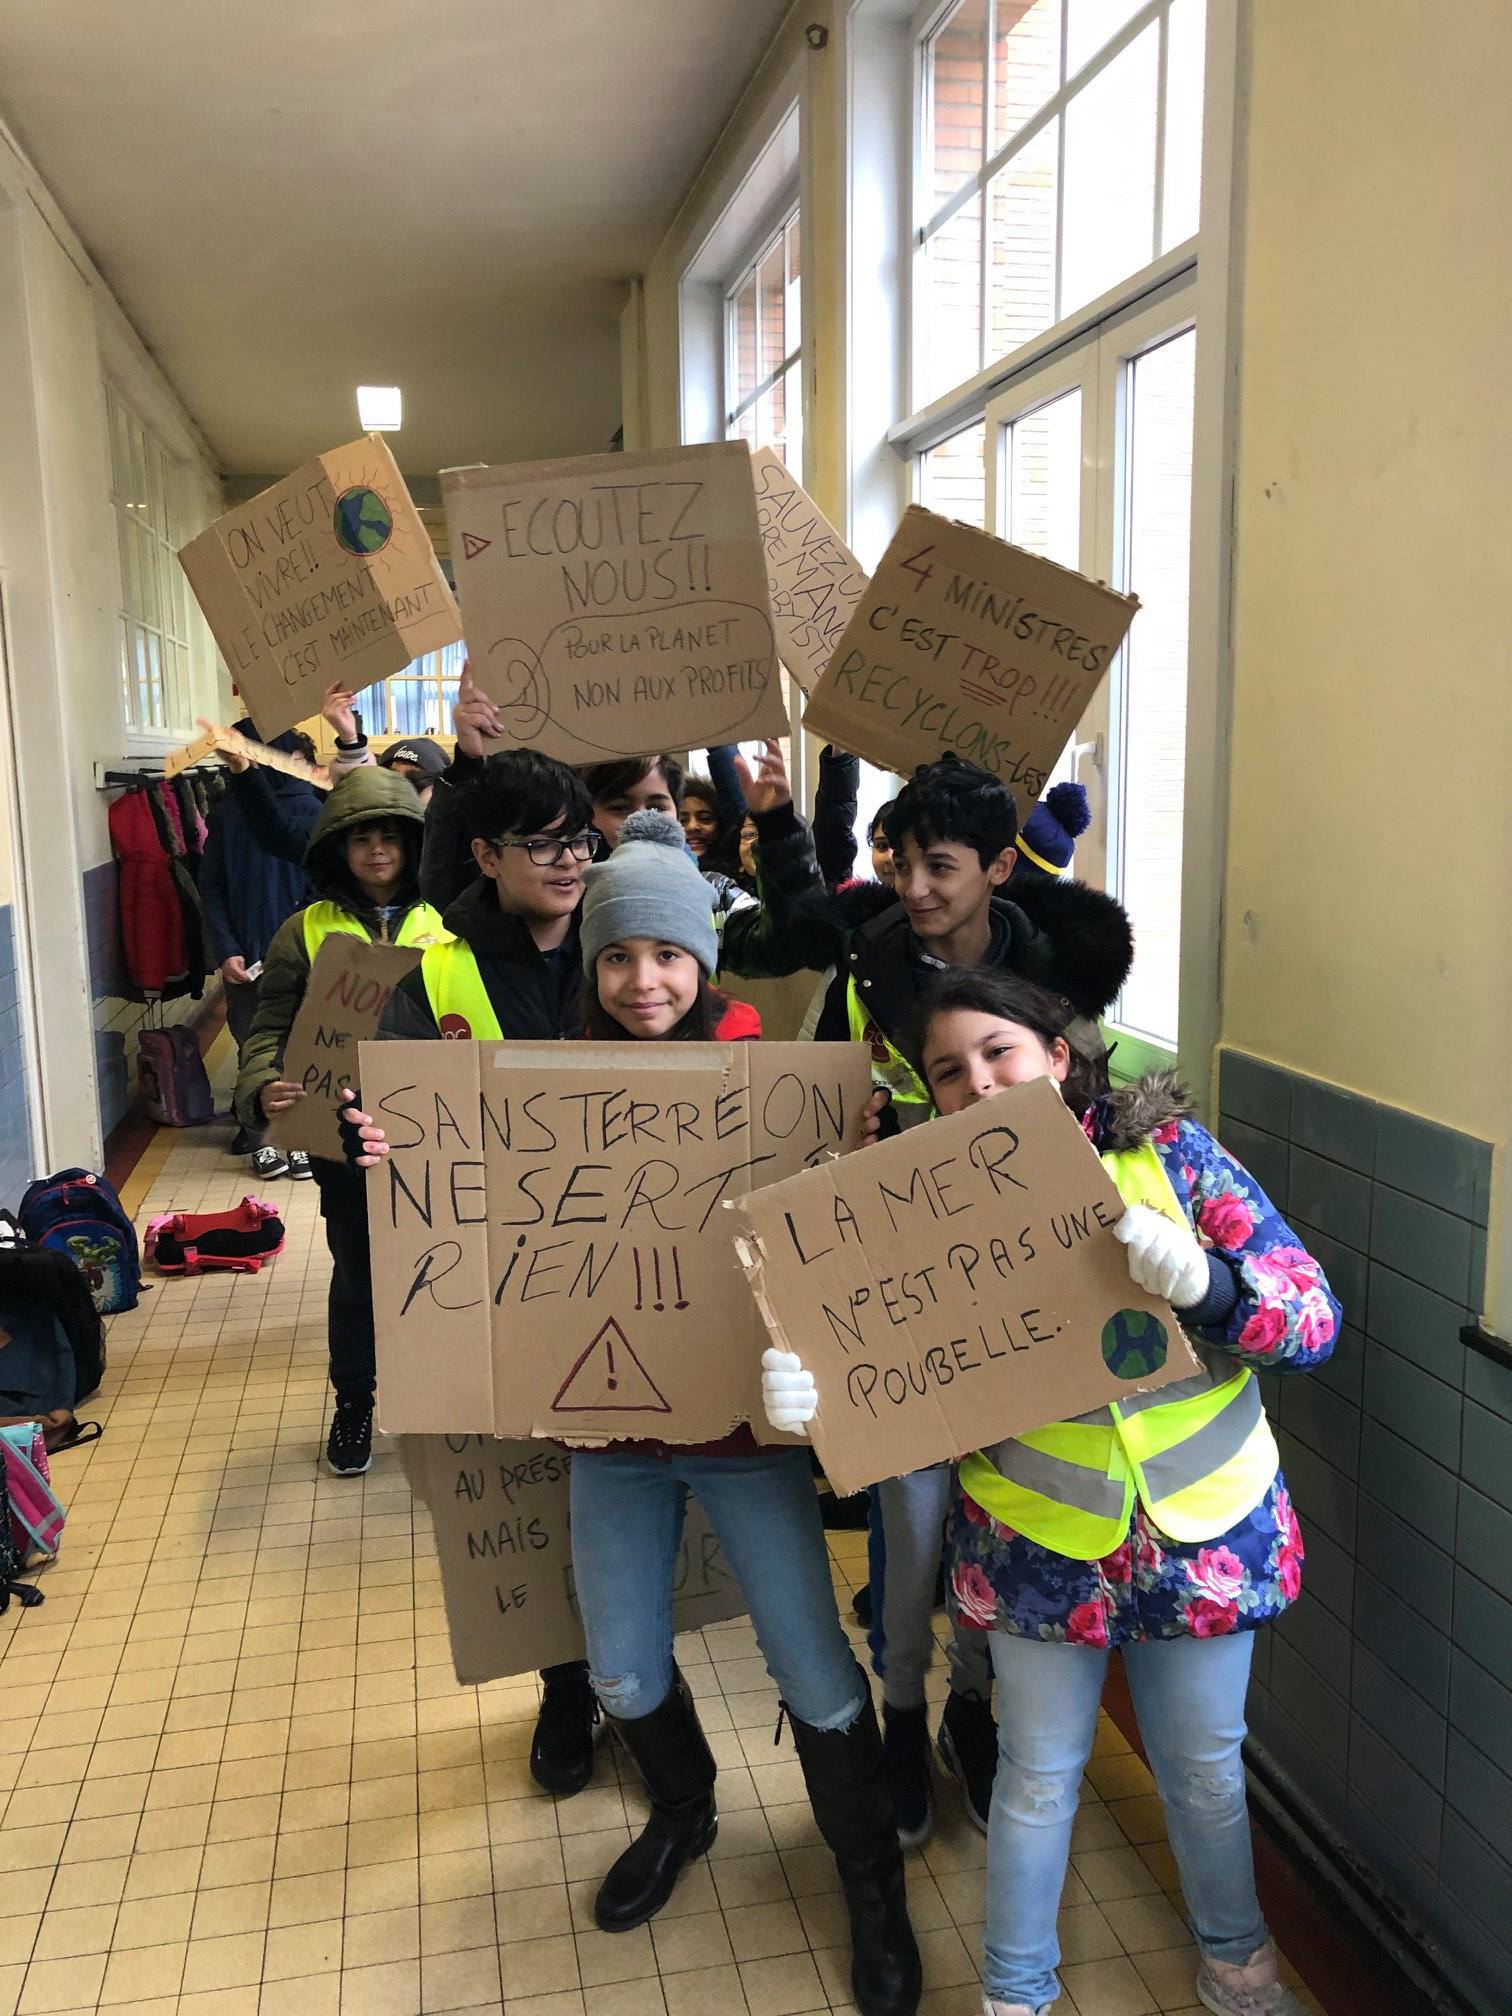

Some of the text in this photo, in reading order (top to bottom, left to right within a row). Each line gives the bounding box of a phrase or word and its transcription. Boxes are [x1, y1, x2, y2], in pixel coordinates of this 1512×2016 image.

[228, 477, 331, 569] ON VEUT
[502, 482, 706, 558] ECOUTEZ
[756, 465, 847, 576] SAUVEZ
[561, 544, 711, 612] NOUS!!
[900, 545, 936, 592] 4
[231, 564, 377, 670] LE CHANGEMENT
[562, 618, 740, 660] POUR LA PLANET
[282, 640, 320, 686] C'EST
[573, 657, 769, 711] NON AUX PROFITS
[314, 1026, 352, 1049] NE
[379, 1073, 844, 1153] SANS TERRE ON
[387, 1153, 777, 1232] NE SERT
[784, 1126, 1028, 1265] LA MER
[947, 1227, 1037, 1291] PAS
[1050, 1201, 1118, 1249] UNE
[847, 1309, 1062, 1419] POUBELLE.
[454, 1469, 485, 1504] AU
[495, 1583, 528, 1614] LE
